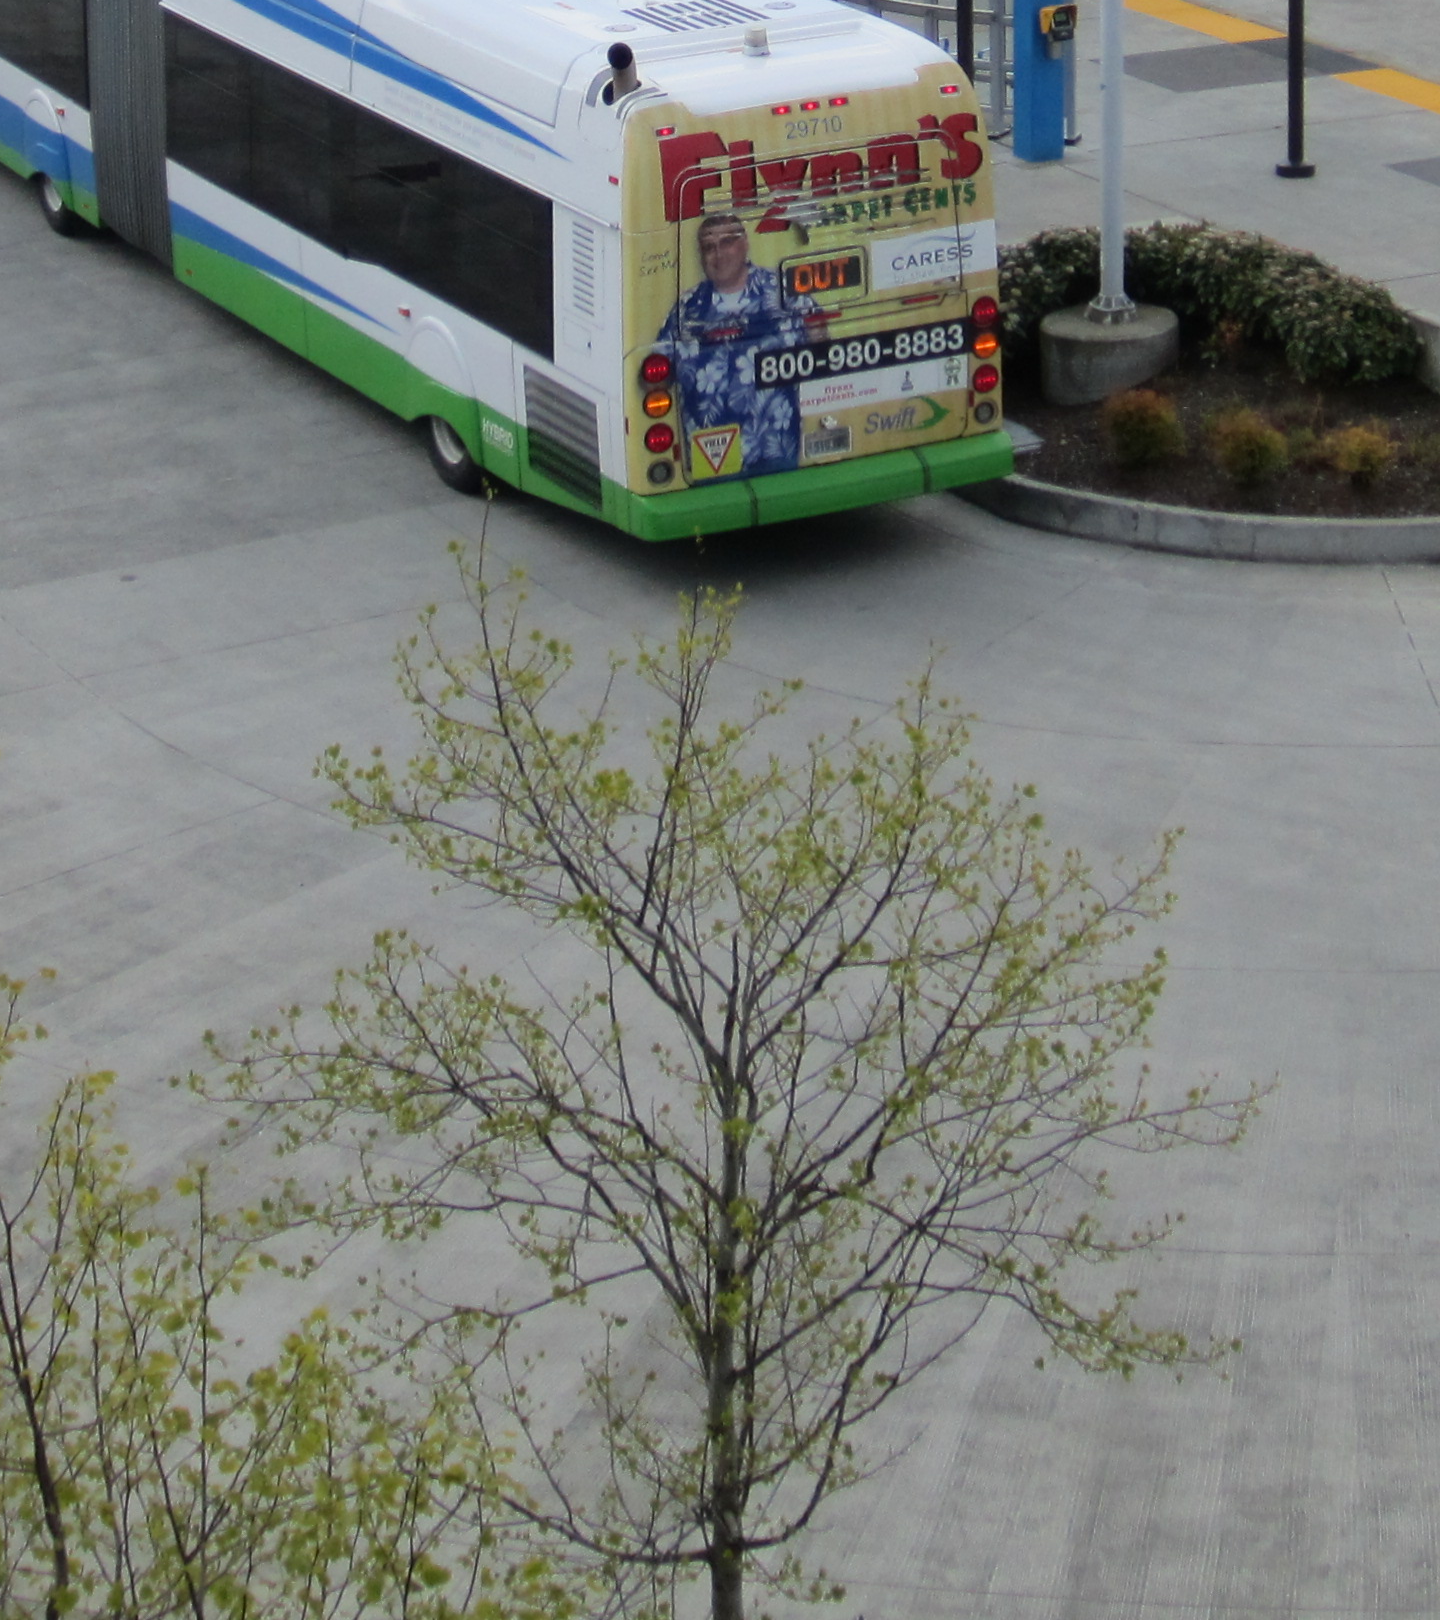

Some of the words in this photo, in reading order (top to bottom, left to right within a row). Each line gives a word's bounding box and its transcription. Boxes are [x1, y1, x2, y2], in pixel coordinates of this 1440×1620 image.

[785, 115, 843, 140] 29710
[891, 244, 974, 271] CARESS
[794, 256, 851, 293] OUT
[760, 323, 964, 383] 800-980-8883
[864, 406, 917, 434] Swift
